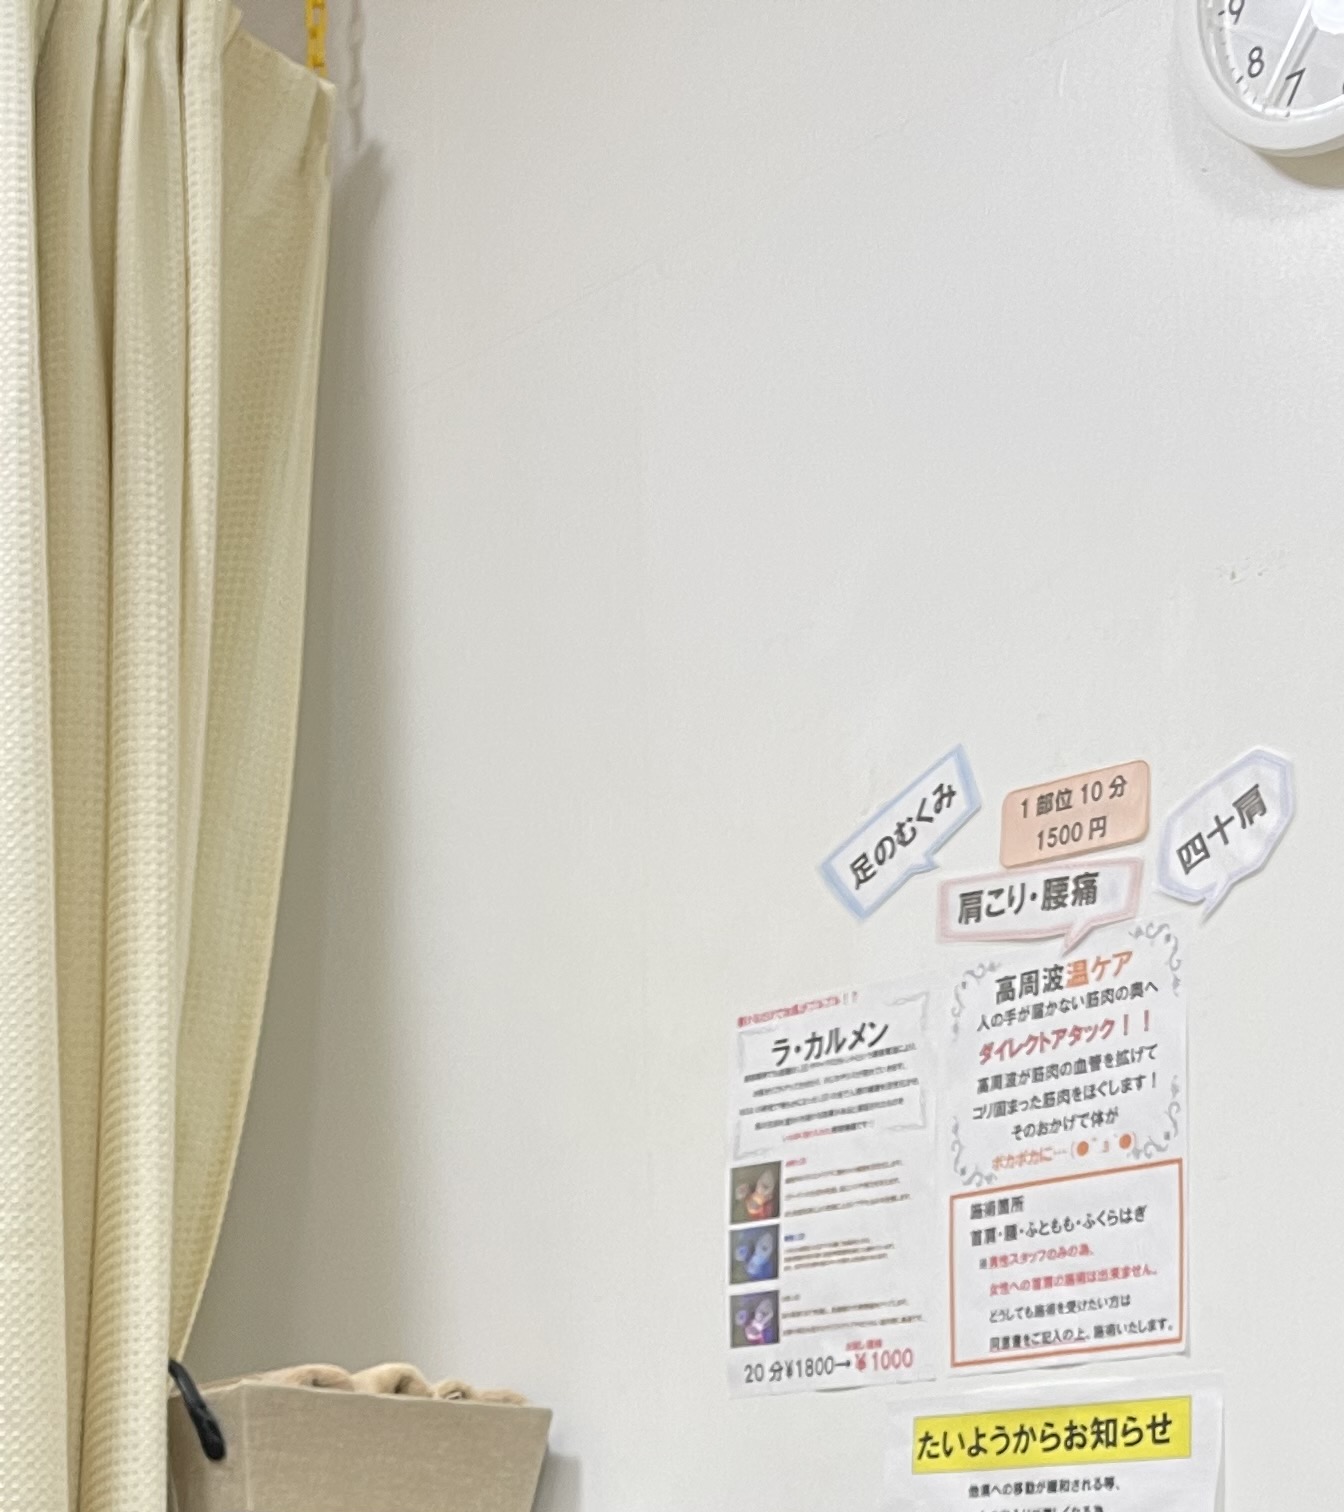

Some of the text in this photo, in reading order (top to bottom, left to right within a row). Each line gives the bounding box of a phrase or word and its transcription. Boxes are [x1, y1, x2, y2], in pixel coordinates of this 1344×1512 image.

[1229, 0, 1245, 25] 9
[1248, 46, 1264, 78] 8
[1285, 68, 1306, 106] 7
[848, 783, 958, 890] 足のむくみ
[1175, 785, 1269, 875] 四十肩
[995, 951, 1133, 1005] 高周波温ケア
[917, 1413, 1172, 1460] たいようからお知らせ
